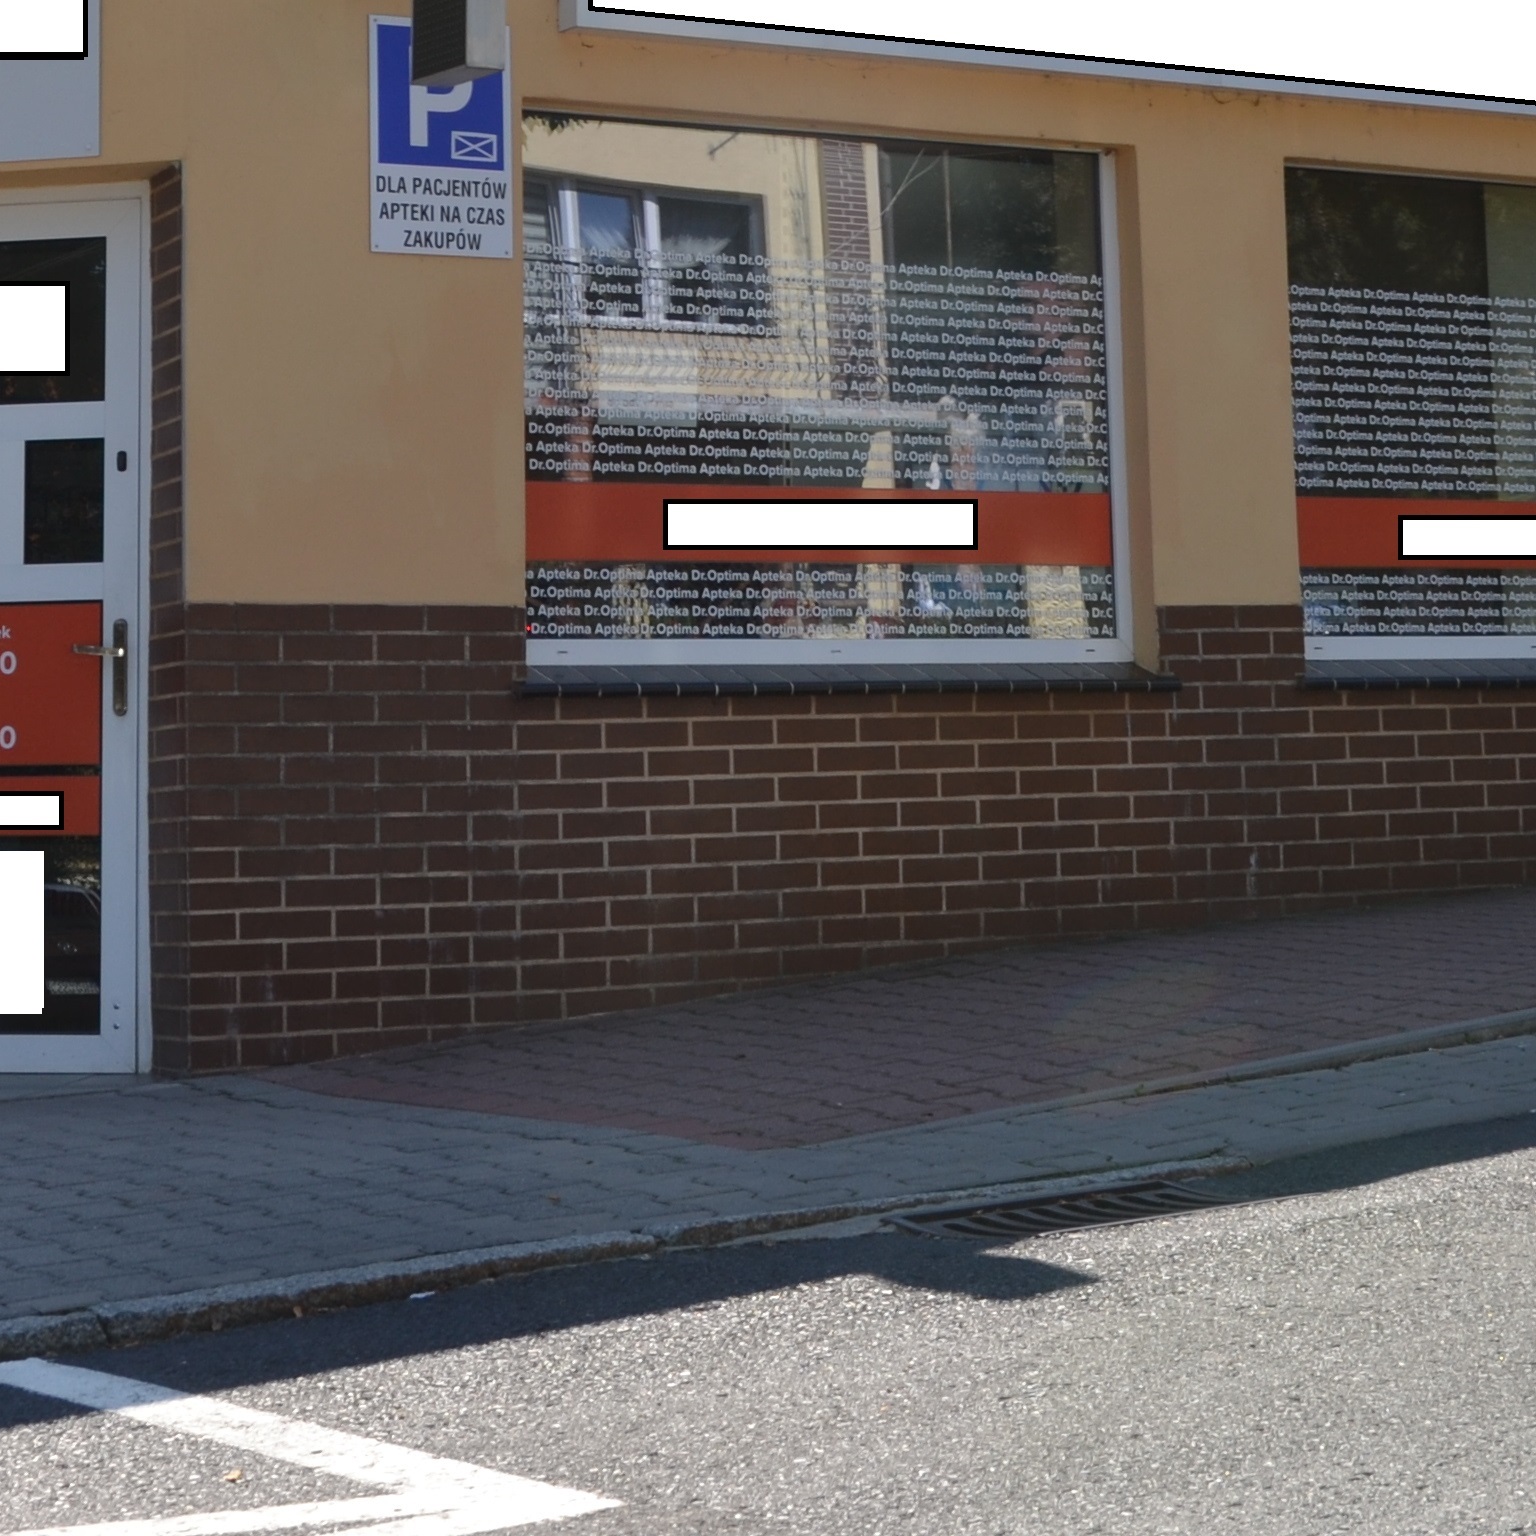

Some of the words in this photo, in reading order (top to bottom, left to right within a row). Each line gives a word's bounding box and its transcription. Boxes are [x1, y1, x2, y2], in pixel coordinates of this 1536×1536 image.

[376, 175, 406, 194] DLA
[412, 177, 507, 200] PACJENTÓW
[379, 202, 435, 222] APTEKI
[440, 205, 461, 224] NA
[466, 207, 505, 225] CZAS
[403, 229, 482, 251] ZAKUPÓW
[899, 263, 937, 277] Apteka
[940, 265, 994, 280] Dr.Optima
[996, 269, 1033, 282] Apteka
[1036, 271, 1088, 285] Dr.Optima
[580, 263, 639, 278] Dr.Optima
[687, 268, 744, 284] Dr.Optima
[890, 280, 945, 295] Dr.Optima
[947, 283, 984, 297] Apteka
[987, 285, 1040, 300] Dr.Optima
[1043, 288, 1079, 302] Apteka
[590, 281, 632, 296] Apteka
[697, 287, 737, 301] Apteka
[900, 297, 938, 311] Apteka
[941, 299, 995, 314] Dr.Optima
[997, 302, 1034, 316] Apteka
[1037, 304, 1089, 319] Dr.Optima
[1328, 287, 1361, 299] Apteka
[1412, 292, 1444, 304] Apteka
[580, 298, 640, 314] Dr.Optima
[687, 304, 745, 319] Dr.Optima
[891, 314, 946, 328] Dr.Optima
[948, 316, 985, 330] Apteka
[988, 318, 1041, 333] Dr.Optima
[1044, 321, 1080, 335] Apteka
[1370, 306, 1402, 317] Apteka
[1330, 319, 1362, 331] Apteka
[1414, 323, 1446, 335] Apteka
[901, 331, 939, 345] Apteka
[942, 333, 996, 348] Dr.Optima
[998, 336, 1035, 349] Apteka
[1038, 337, 1090, 352] Dr.Optima
[1371, 337, 1404, 349] Apteka
[535, 332, 577, 347] Apteka
[892, 348, 946, 362] Dr.Optima
[949, 350, 986, 364] Apteka
[989, 352, 1042, 367] Dr.Optima
[1045, 354, 1081, 368] Apteka
[1331, 351, 1364, 362] Apteka
[1415, 355, 1447, 366] Apteka
[902, 365, 939, 379] Apteka
[943, 367, 997, 381] Dr.Optima
[999, 369, 1036, 383] Apteka
[1039, 371, 1091, 385] Dr.Optima
[1373, 368, 1405, 380] Apteka
[536, 368, 577, 383] Apteka
[893, 382, 947, 397] Dr.Optima
[950, 384, 987, 398] Apteka
[990, 386, 1043, 400] Dr.Optima
[1046, 388, 1082, 402] Apteka
[1332, 382, 1365, 394] Apteka
[1417, 386, 1449, 398] Apteka
[1374, 400, 1407, 412] Apteka
[991, 419, 1045, 434] Dr.Optima
[1334, 414, 1367, 426] Apteka
[1418, 417, 1450, 429] Apteka
[529, 422, 590, 438] Dr.Optima
[593, 424, 634, 439] Apteka
[638, 425, 697, 441] Dr.Optima
[699, 427, 740, 442] Apteka
[743, 429, 800, 444] Dr.Optima
[1001, 437, 1038, 450] Apteka
[1376, 432, 1408, 443] Apteka
[537, 441, 579, 455] Apteka
[583, 442, 642, 457] Dr.Optima
[645, 444, 686, 458] Apteka
[690, 445, 748, 460] Dr.Optima
[751, 447, 790, 461] Apteka
[794, 448, 850, 462] Dr.Optima
[1335, 446, 1368, 458] Apteka
[1420, 449, 1452, 460] Apteka
[529, 458, 590, 474] Dr.Optima
[593, 460, 634, 475] Apteka
[638, 461, 697, 476] Dr.Optima
[700, 463, 740, 477] Apteka
[744, 464, 801, 479] Dr.Optima
[1377, 463, 1410, 475] Apteka
[1336, 478, 1369, 490] Apteka
[1421, 480, 1453, 492] Apteka
[538, 568, 580, 583] Apteka
[647, 569, 688, 584] Apteka
[692, 570, 750, 584] Dr.Optima
[753, 570, 793, 584] Apteka
[1382, 575, 1415, 587] Apteka
[531, 586, 592, 601] Dr.Optima
[640, 587, 700, 602] Dr.Optima
[702, 588, 743, 602] Apteka
[1341, 591, 1374, 603] Apteka
[1426, 592, 1459, 603] Apteka
[538, 605, 581, 619] Apteka
[648, 605, 689, 620] Apteka
[693, 605, 751, 620] Dr.Optima
[754, 606, 793, 620] Apteka
[797, 606, 854, 620] Dr.Optima
[1383, 607, 1416, 619] Apteka
[1467, 608, 1499, 619] Apteka
[531, 623, 592, 638] Dr.Optima
[595, 623, 637, 638] Apteka
[641, 623, 700, 638] Dr.Optima
[703, 623, 743, 638] Apteka
[908, 624, 946, 638] Apteka
[950, 624, 1004, 638] Dr.Optima
[1343, 623, 1376, 635] Apteka
[1428, 623, 1460, 635] Apteka
